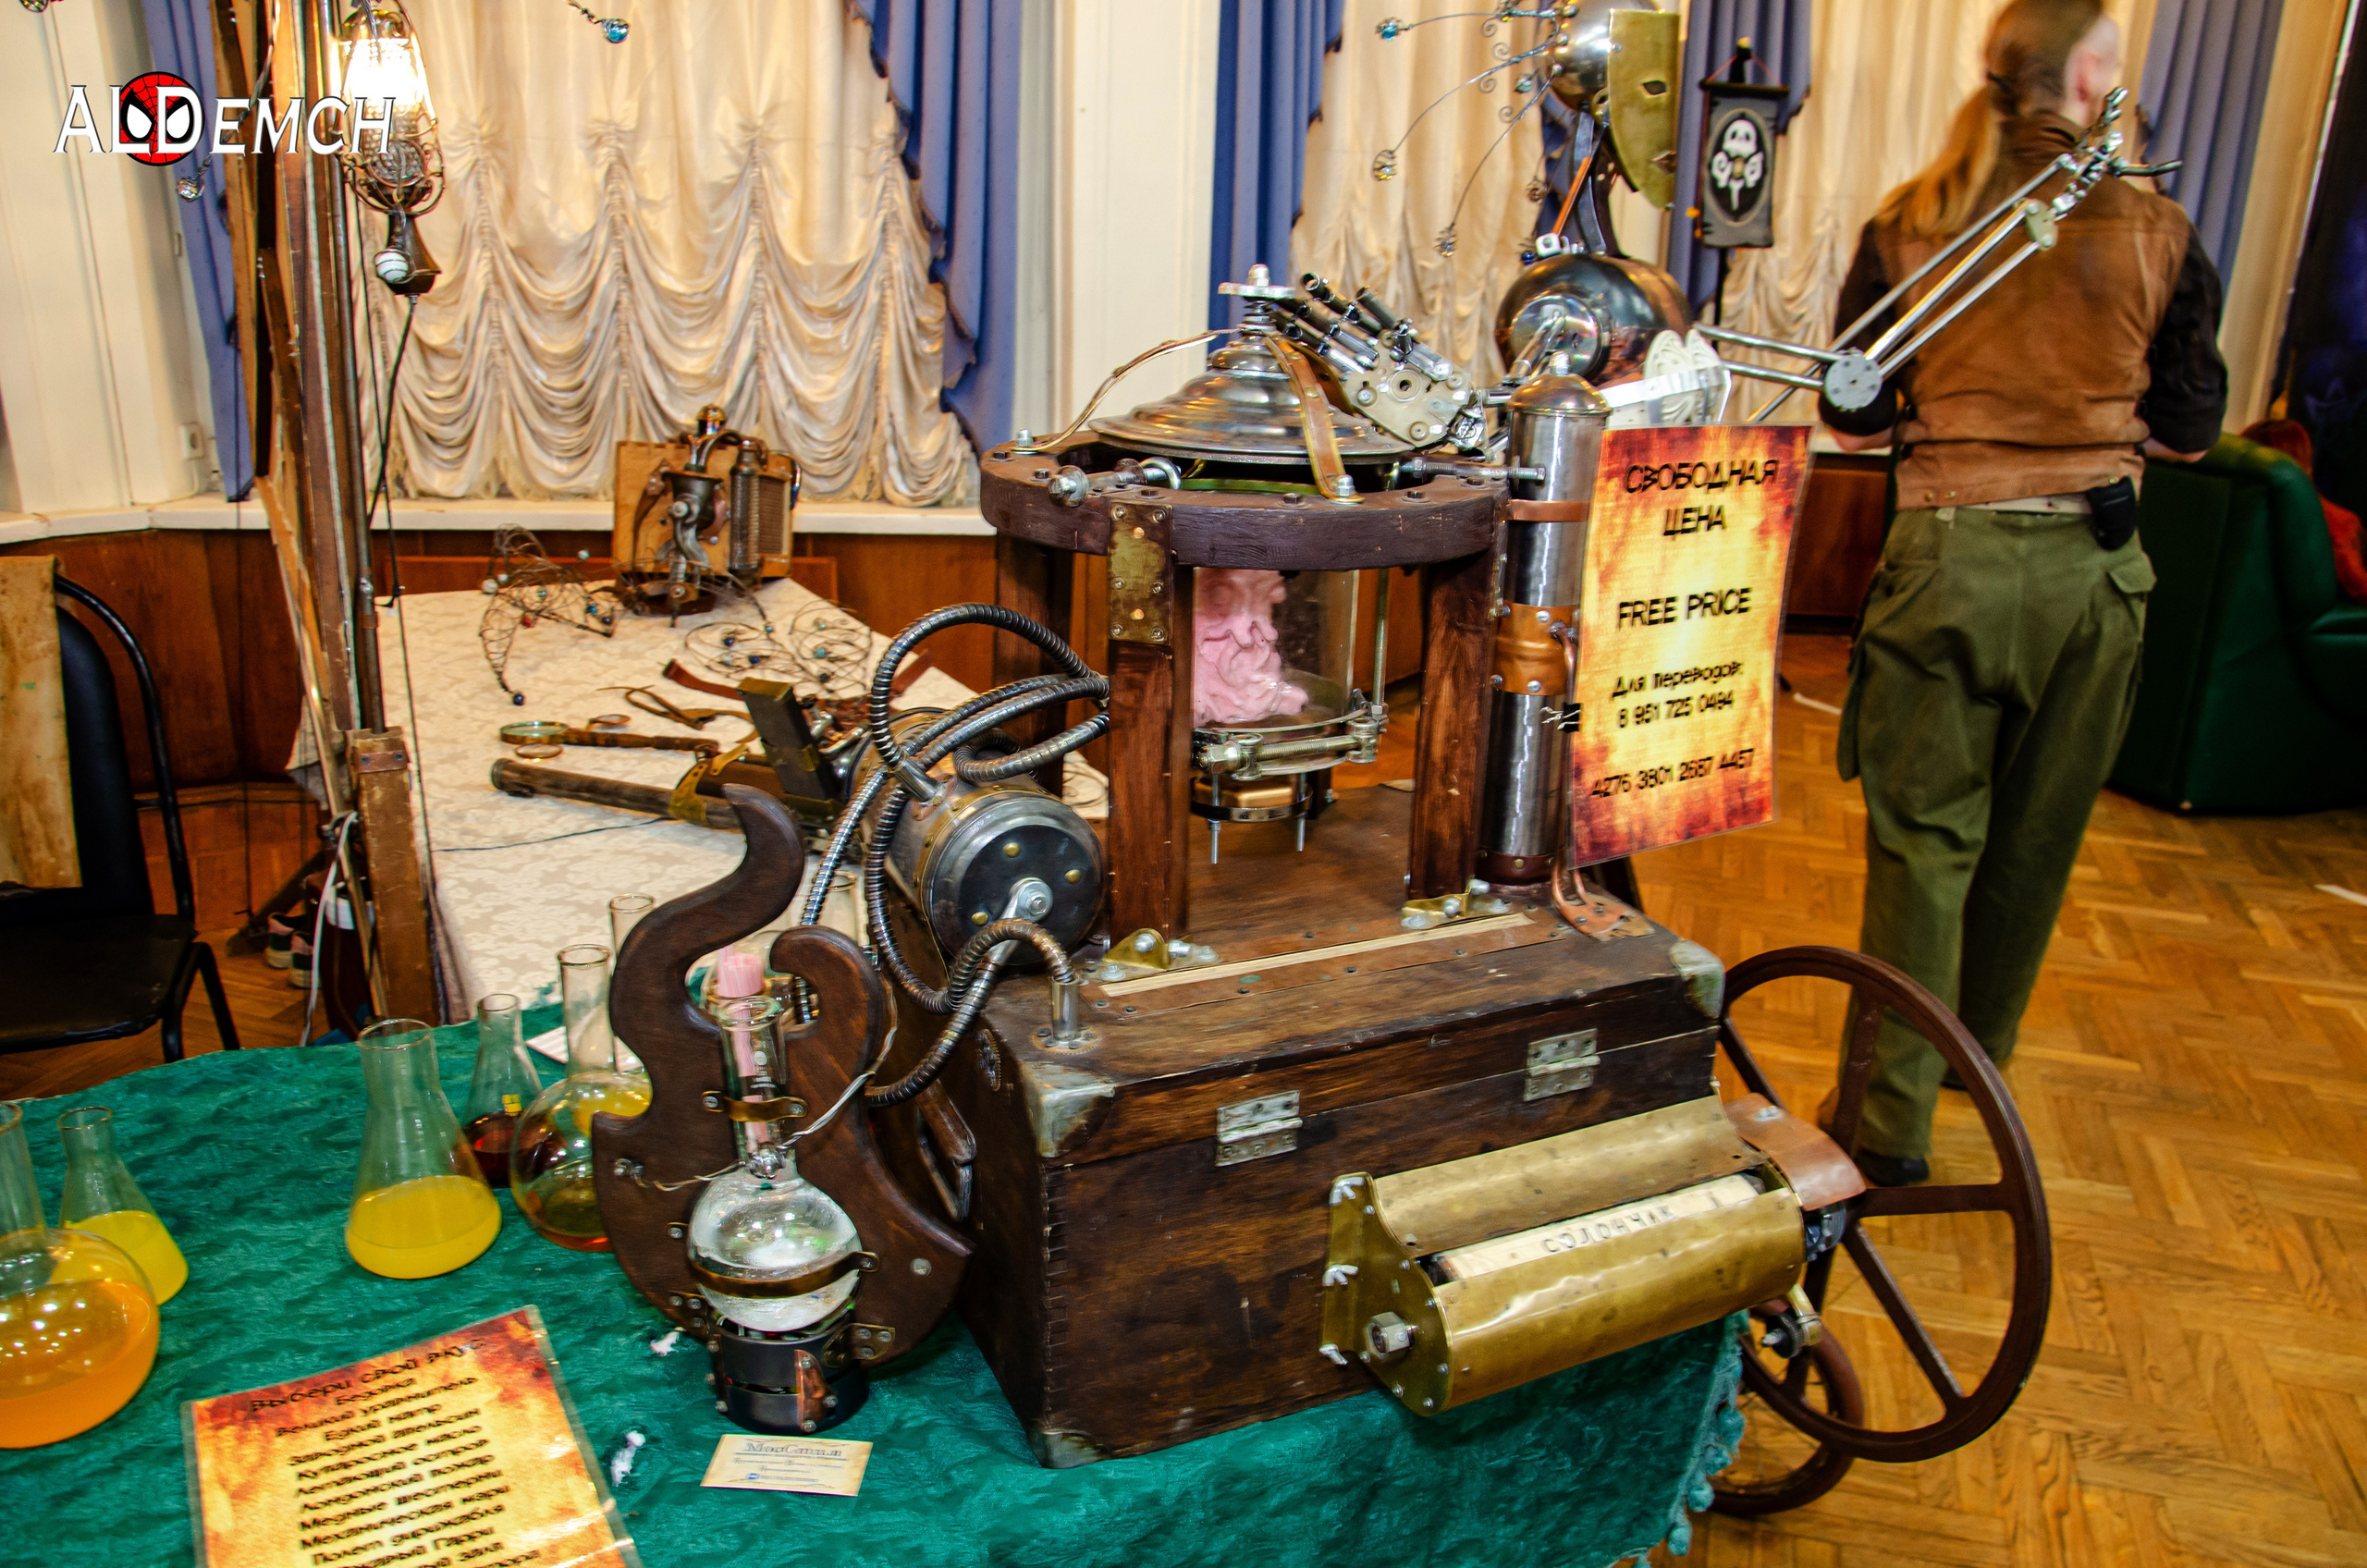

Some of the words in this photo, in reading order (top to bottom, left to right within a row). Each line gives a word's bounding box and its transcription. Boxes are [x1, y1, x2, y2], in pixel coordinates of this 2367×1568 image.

[1625, 459, 1780, 494] СВОБОДНАЯ
[1662, 504, 1726, 541] ЦЕНА
[1617, 595, 1678, 631] FREE
[1686, 587, 1752, 619] PRICE
[1610, 676, 1647, 701] Для
[1618, 707, 1628, 729] 8
[1633, 702, 1661, 725] 951
[1665, 696, 1694, 718] 725
[1590, 773, 1632, 798] 4276
[1717, 747, 1755, 771] 4457
